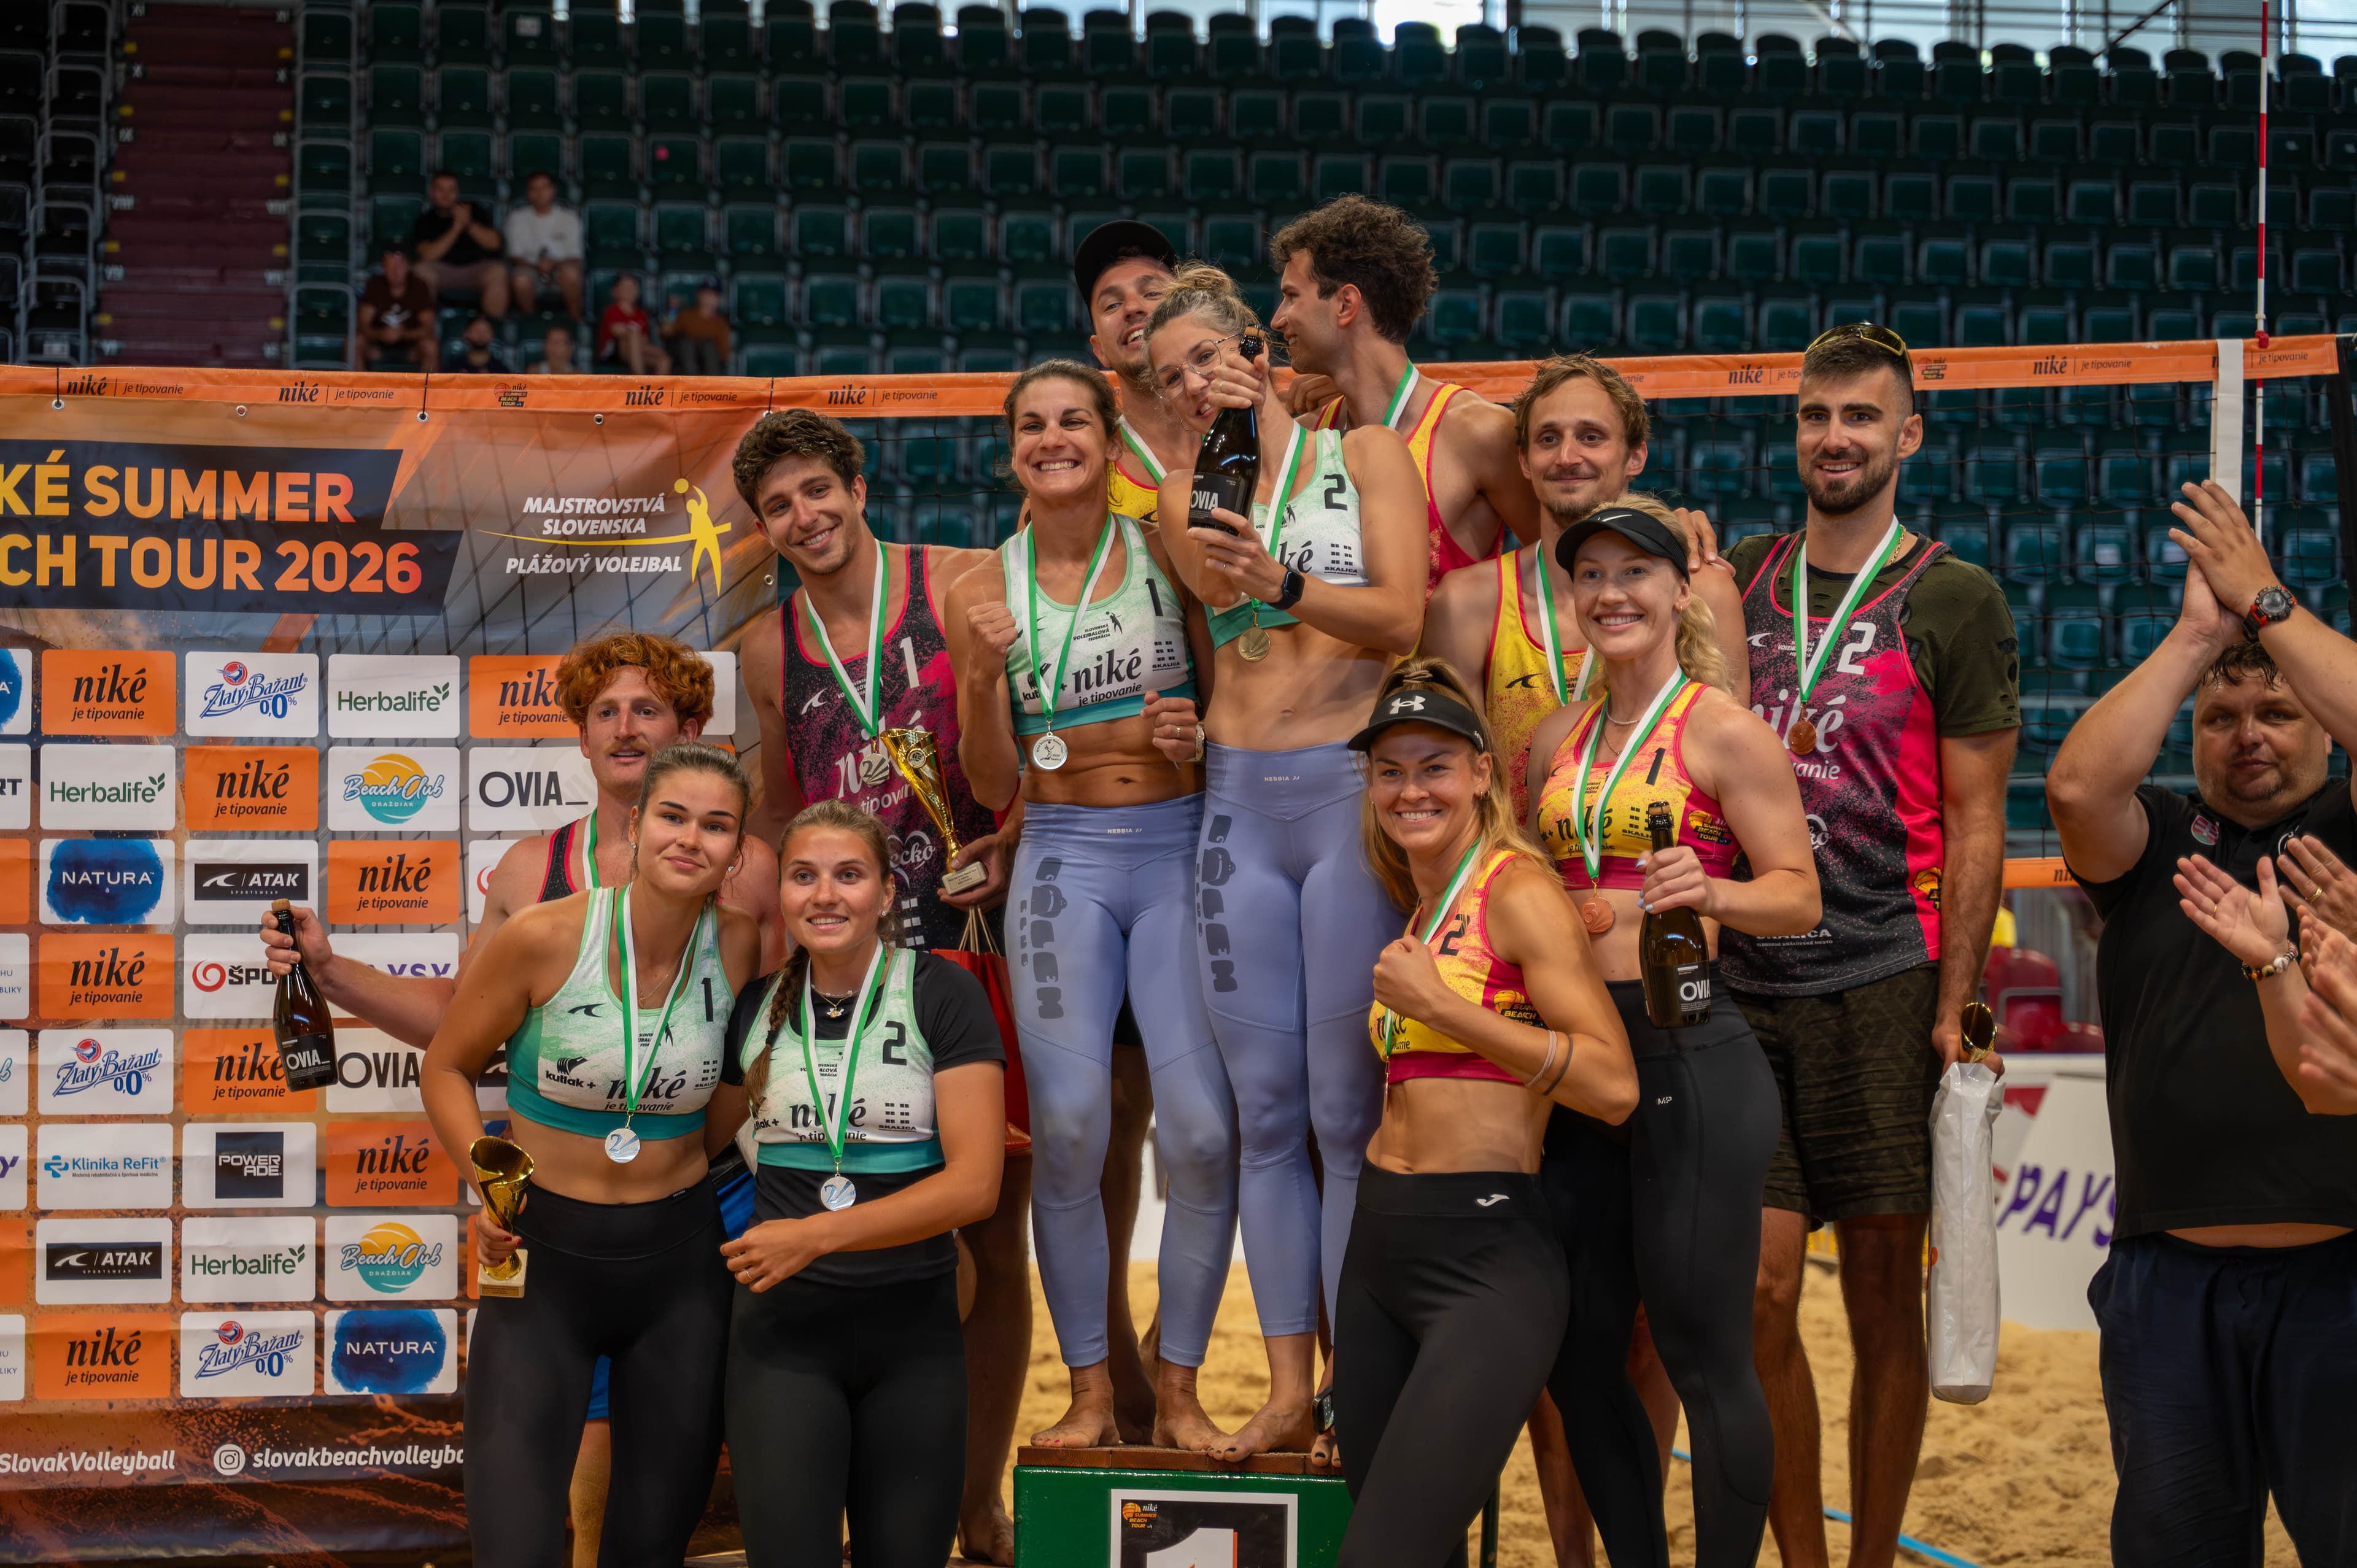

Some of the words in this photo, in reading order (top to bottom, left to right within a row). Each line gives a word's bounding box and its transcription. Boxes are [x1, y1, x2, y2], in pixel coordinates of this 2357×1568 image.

[2034, 357, 2067, 375] niké
[2081, 360, 2090, 371] je
[2091, 358, 2132, 370] tipovanie
[2268, 351, 2309, 363] tipovanie
[66, 374, 107, 396] niké
[122, 382, 134, 395] je
[136, 382, 184, 396] tipovanie
[1728, 364, 1763, 385] niké
[279, 380, 319, 403] niké
[333, 387, 344, 401] je
[346, 388, 394, 401] tipovanie
[625, 384, 664, 406] niké
[678, 391, 689, 404] je
[691, 391, 737, 403] tipovanie
[828, 384, 867, 406] niké
[880, 391, 891, 403] je
[892, 389, 938, 402] tipovanie
[83, 465, 356, 523] SUMMER
[522, 492, 665, 514] MAJSTROVSTVÁ
[1323, 474, 1348, 511] 2
[543, 518, 646, 535] SLOVENSKA
[89, 535, 265, 590] TOUR
[274, 540, 422, 594] 2026
[506, 552, 591, 574] PLÁŽOVÝ
[595, 557, 682, 573] VOLEJBAL
[1145, 578, 1164, 616] 1
[1836, 622, 1876, 674] 2
[900, 637, 919, 689] 1
[1072, 647, 1142, 693] niké
[73, 664, 146, 703] niké
[1078, 696, 1089, 706] je
[1090, 683, 1142, 703] tipovanie
[199, 682, 247, 718] Zlatý
[247, 673, 306, 705] Bažant
[338, 691, 441, 712] Herbalife
[71, 708, 85, 722] je
[87, 707, 145, 721] tipovanie
[498, 712, 511, 725] je
[513, 711, 568, 725] tipovanie
[1646, 747, 1665, 786] 1
[216, 759, 290, 798] niké
[344, 775, 404, 801] Beach
[401, 774, 444, 800] Club
[51, 781, 156, 803] Herbalife
[215, 803, 226, 817] je
[230, 803, 287, 817] tipovanie
[1699, 833, 1718, 842] TOUR
[62, 872, 152, 884] NATURA
[248, 873, 300, 887] ATAK
[357, 854, 432, 892] niké
[357, 897, 370, 911] je
[371, 896, 428, 910] tipovanie
[1439, 913, 1471, 956] 2
[70, 947, 145, 987] niké
[69, 991, 82, 1006] je
[84, 991, 143, 1004] tipovanie
[701, 977, 714, 1022] 1
[1680, 979, 1711, 1001] OVIA
[1504, 1010, 1536, 1019] BEACH
[883, 1021, 907, 1066] 2
[52, 1062, 102, 1097] Zlatý
[102, 1048, 162, 1081] Bažant
[546, 1070, 584, 1089] kutlak
[606, 1066, 687, 1100] nké
[213, 1086, 225, 1100] je
[228, 1086, 285, 1100] tipovanie
[72, 1156, 118, 1170] Klinika
[123, 1156, 159, 1170] ReFit
[219, 1155, 281, 1165] POWER
[357, 1135, 429, 1174] niké
[244, 1166, 281, 1176] ADE
[355, 1179, 367, 1193] je
[369, 1178, 427, 1192] tipovanie
[101, 1252, 153, 1265] ATAK
[192, 1254, 296, 1275] Herbalife
[341, 1243, 400, 1270] Beach
[399, 1243, 442, 1269] Club
[66, 1326, 141, 1367] niké
[195, 1344, 244, 1380] Zlatý
[244, 1330, 303, 1362] Bažant
[346, 1342, 435, 1354] NATURA
[65, 1371, 78, 1386] je
[80, 1370, 139, 1385] tipovanie
[0, 1450, 176, 1475] SlovakVolleyball
[1142, 1503, 1158, 1512] niké
